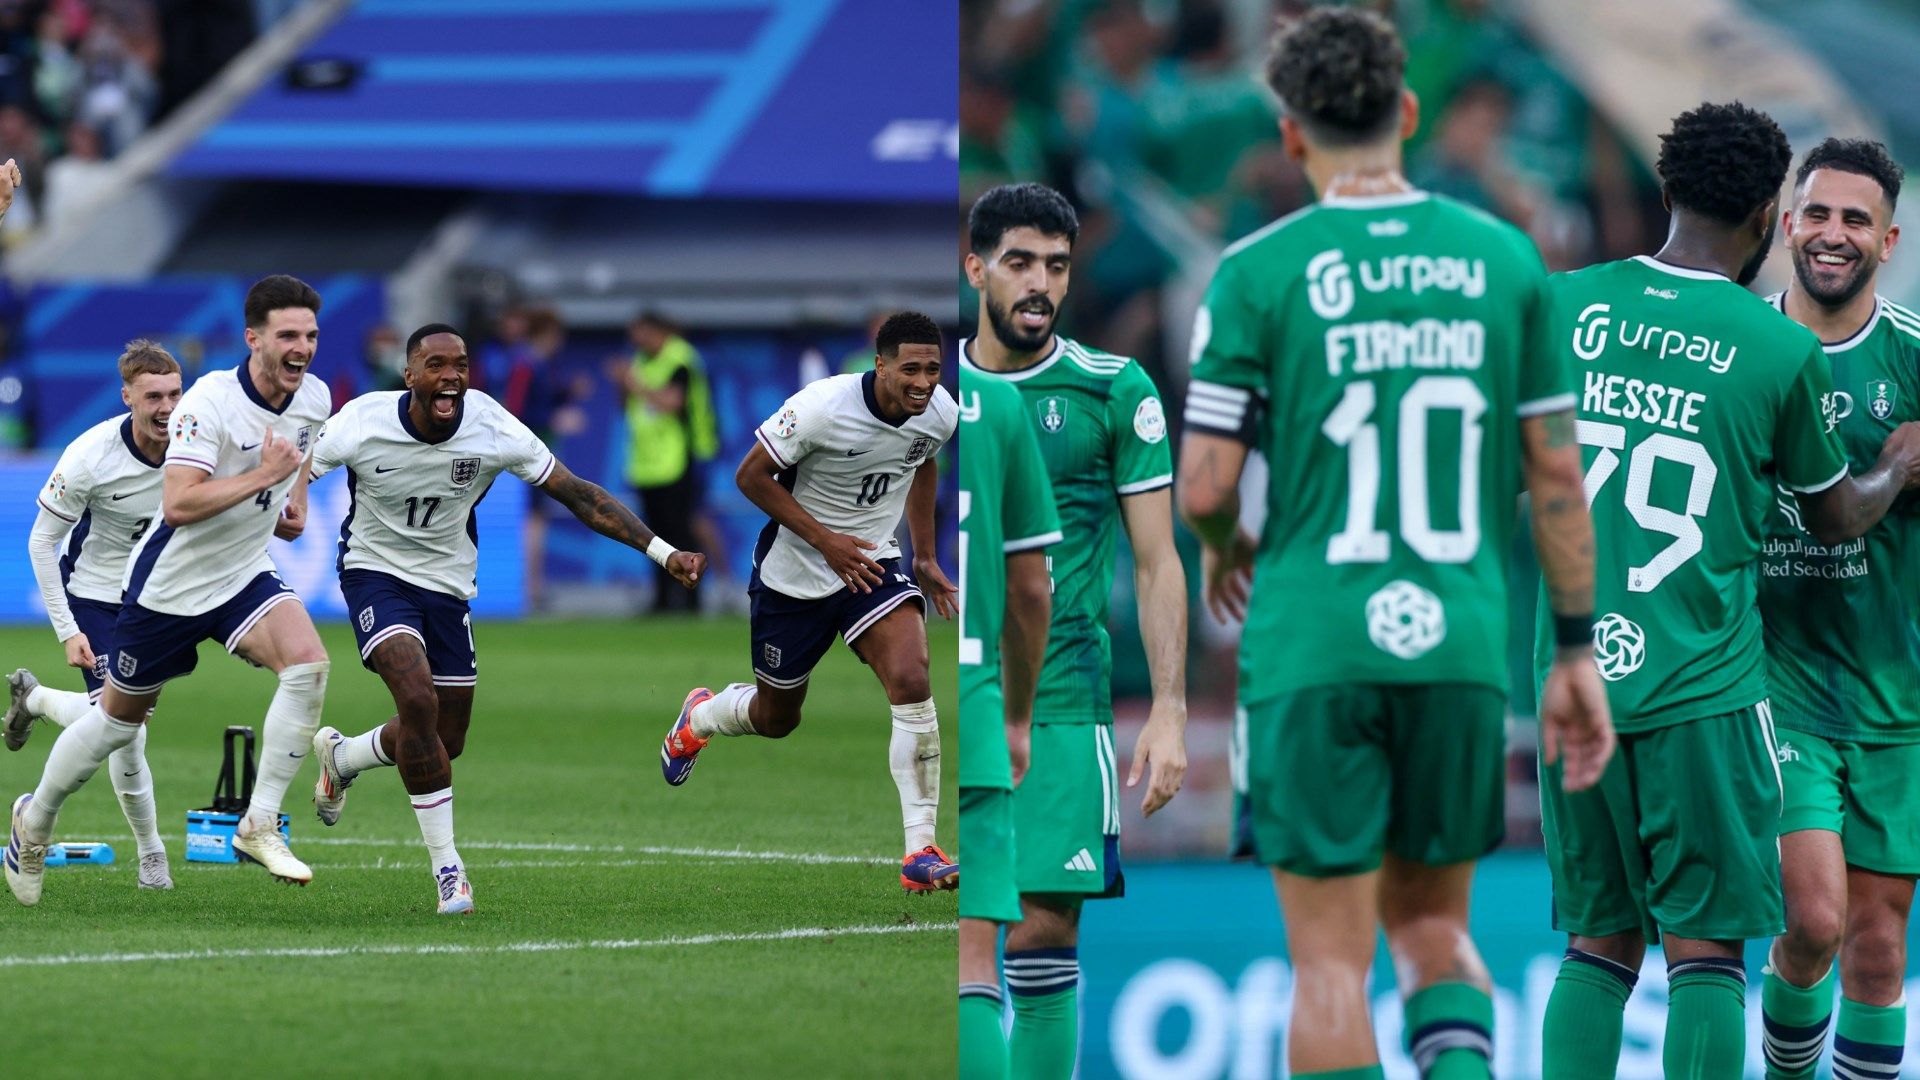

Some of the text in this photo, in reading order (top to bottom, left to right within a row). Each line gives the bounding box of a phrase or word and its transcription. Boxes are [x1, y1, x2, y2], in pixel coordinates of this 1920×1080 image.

[1359, 255, 1486, 298] urpay
[1325, 318, 1485, 376] FIRMINO
[1618, 320, 1737, 374] urpay
[1582, 371, 1707, 434] KESSIE
[856, 472, 890, 506] 10
[1322, 376, 1488, 564] 10
[255, 489, 272, 511] 4
[405, 496, 442, 528] 17
[1574, 419, 1718, 593] 79
[1762, 558, 1869, 579] Red Sea Global
